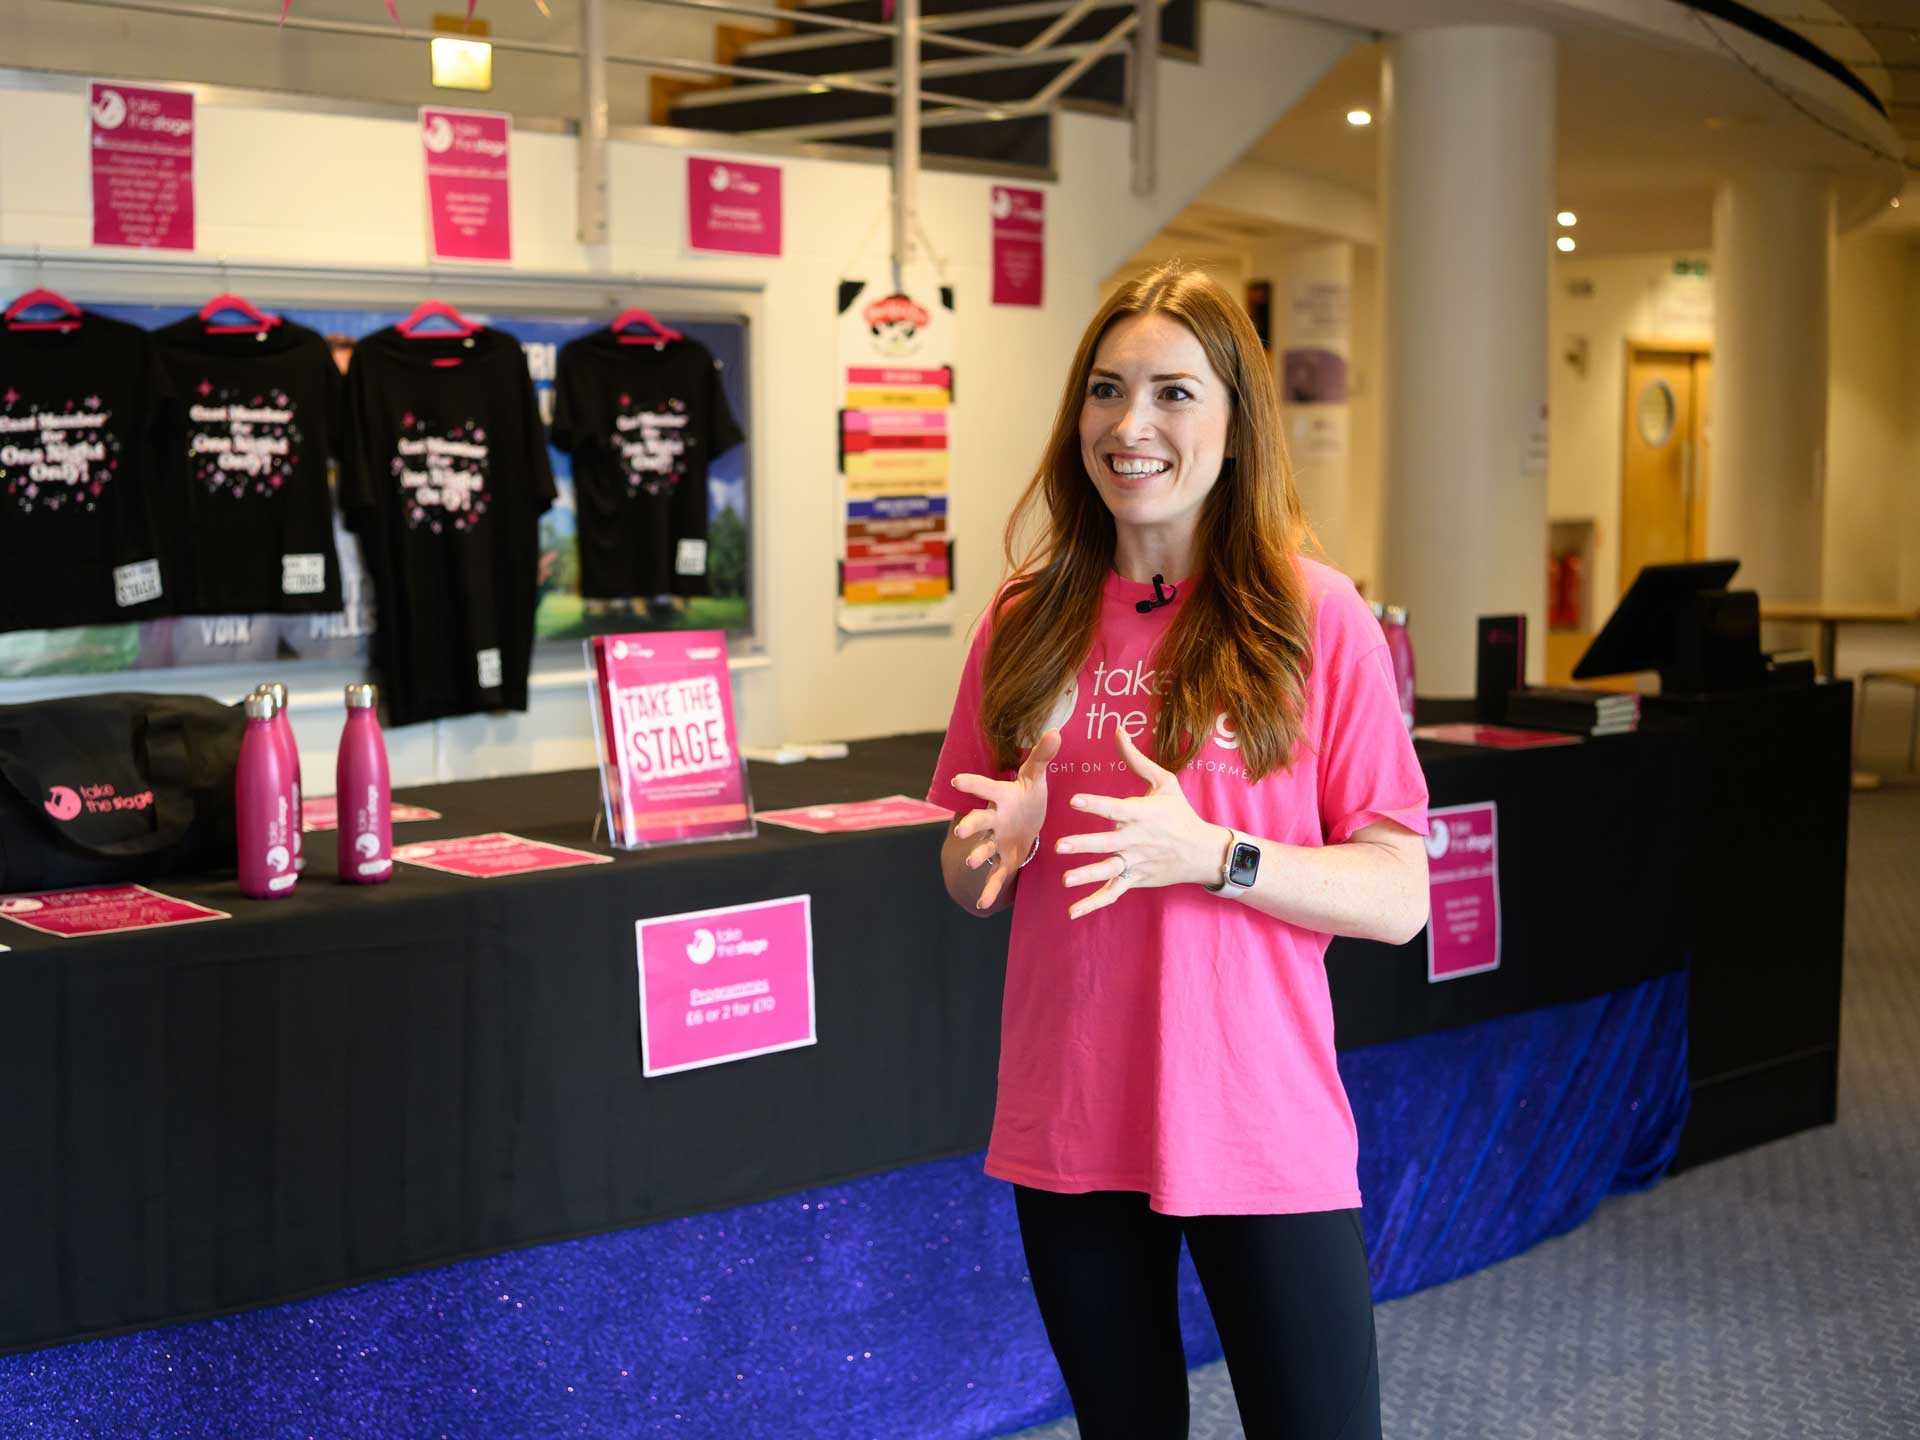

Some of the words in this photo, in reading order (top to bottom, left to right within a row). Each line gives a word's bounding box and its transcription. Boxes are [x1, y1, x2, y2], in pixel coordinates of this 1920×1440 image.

[0, 445, 44, 465] One
[46, 441, 105, 468] Night
[193, 433, 232, 453] One
[233, 433, 289, 459] Night
[29, 461, 89, 485] Only!
[218, 453, 272, 476] Only!
[625, 688, 673, 721] TAKE
[679, 683, 716, 713] THE
[1085, 702, 1148, 740] the
[632, 719, 724, 774] STAGE
[1049, 762, 1075, 773] GHT
[1081, 762, 1101, 773] ON
[1109, 760, 1127, 772] YO
[1186, 759, 1248, 779] RFORME
[705, 1008, 721, 1023] or
[721, 1003, 731, 1020] 2
[731, 1001, 751, 1017] for
